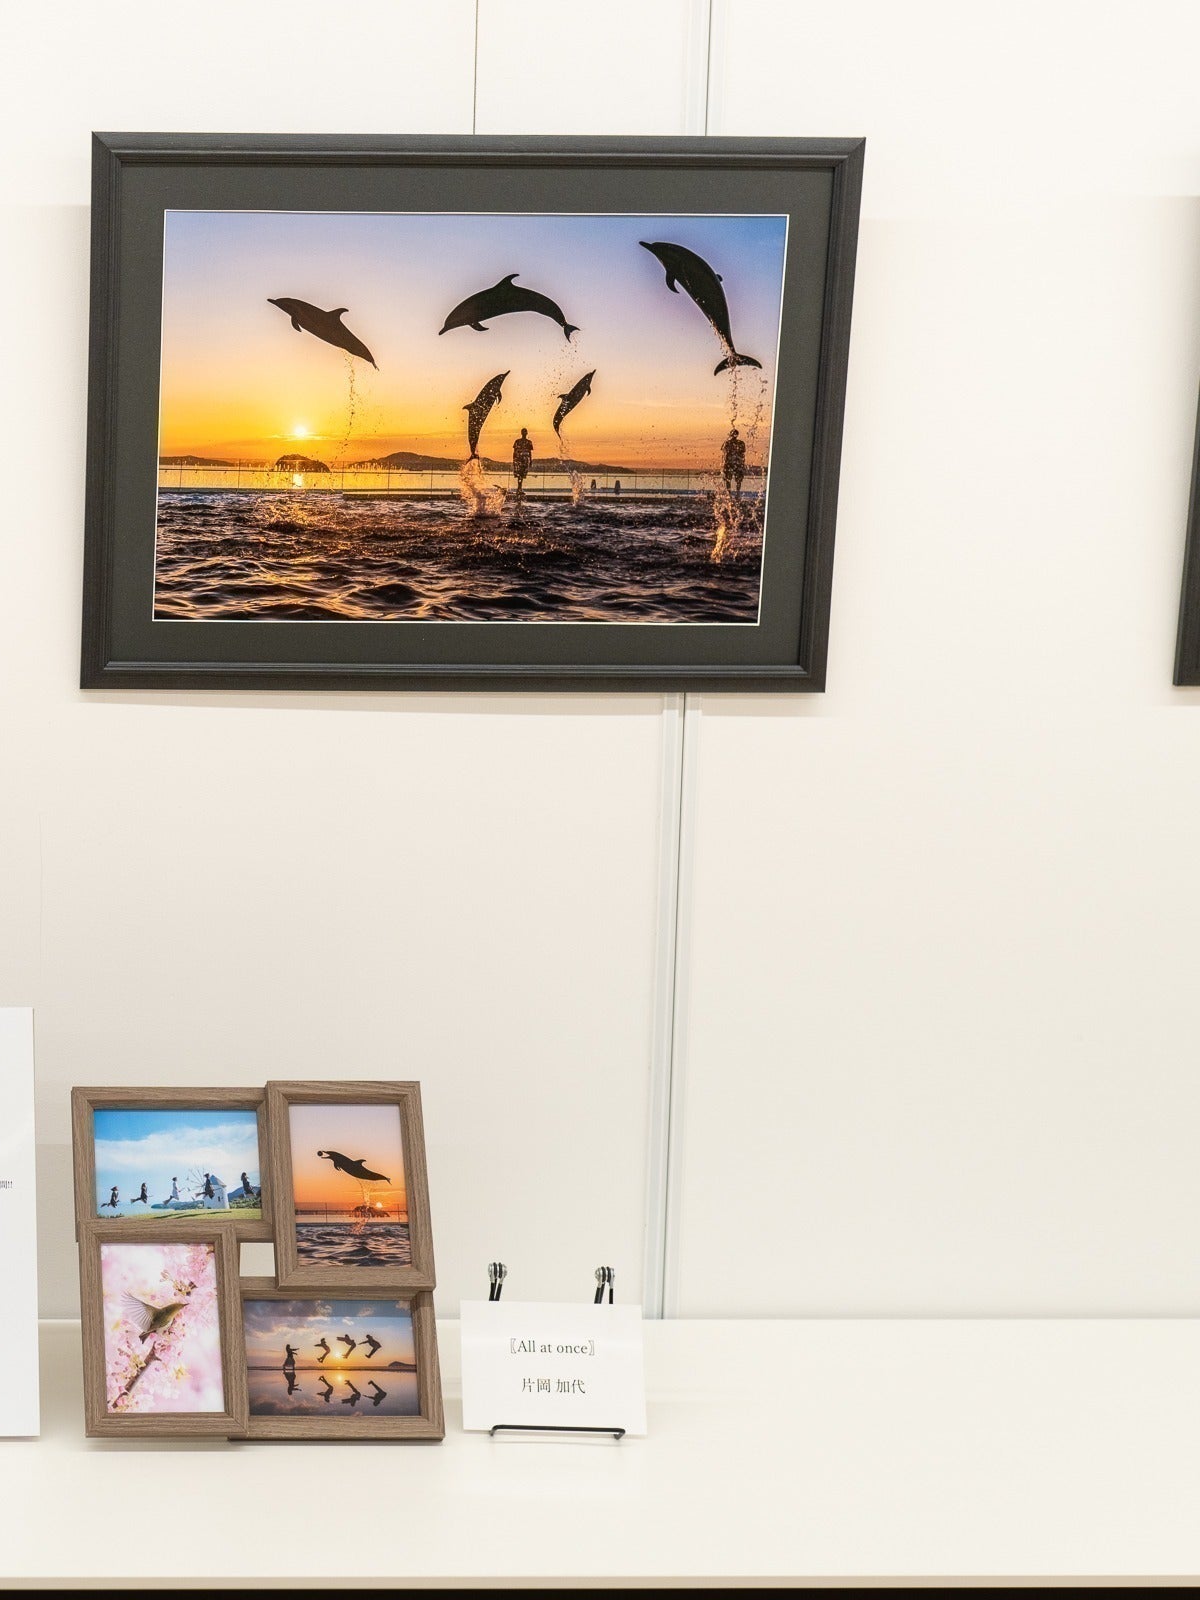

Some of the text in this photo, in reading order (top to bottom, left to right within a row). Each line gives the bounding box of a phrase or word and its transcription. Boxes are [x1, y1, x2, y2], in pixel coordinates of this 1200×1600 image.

[540, 1343, 552, 1353] at
[522, 1378, 586, 1394] 片岡 加代
